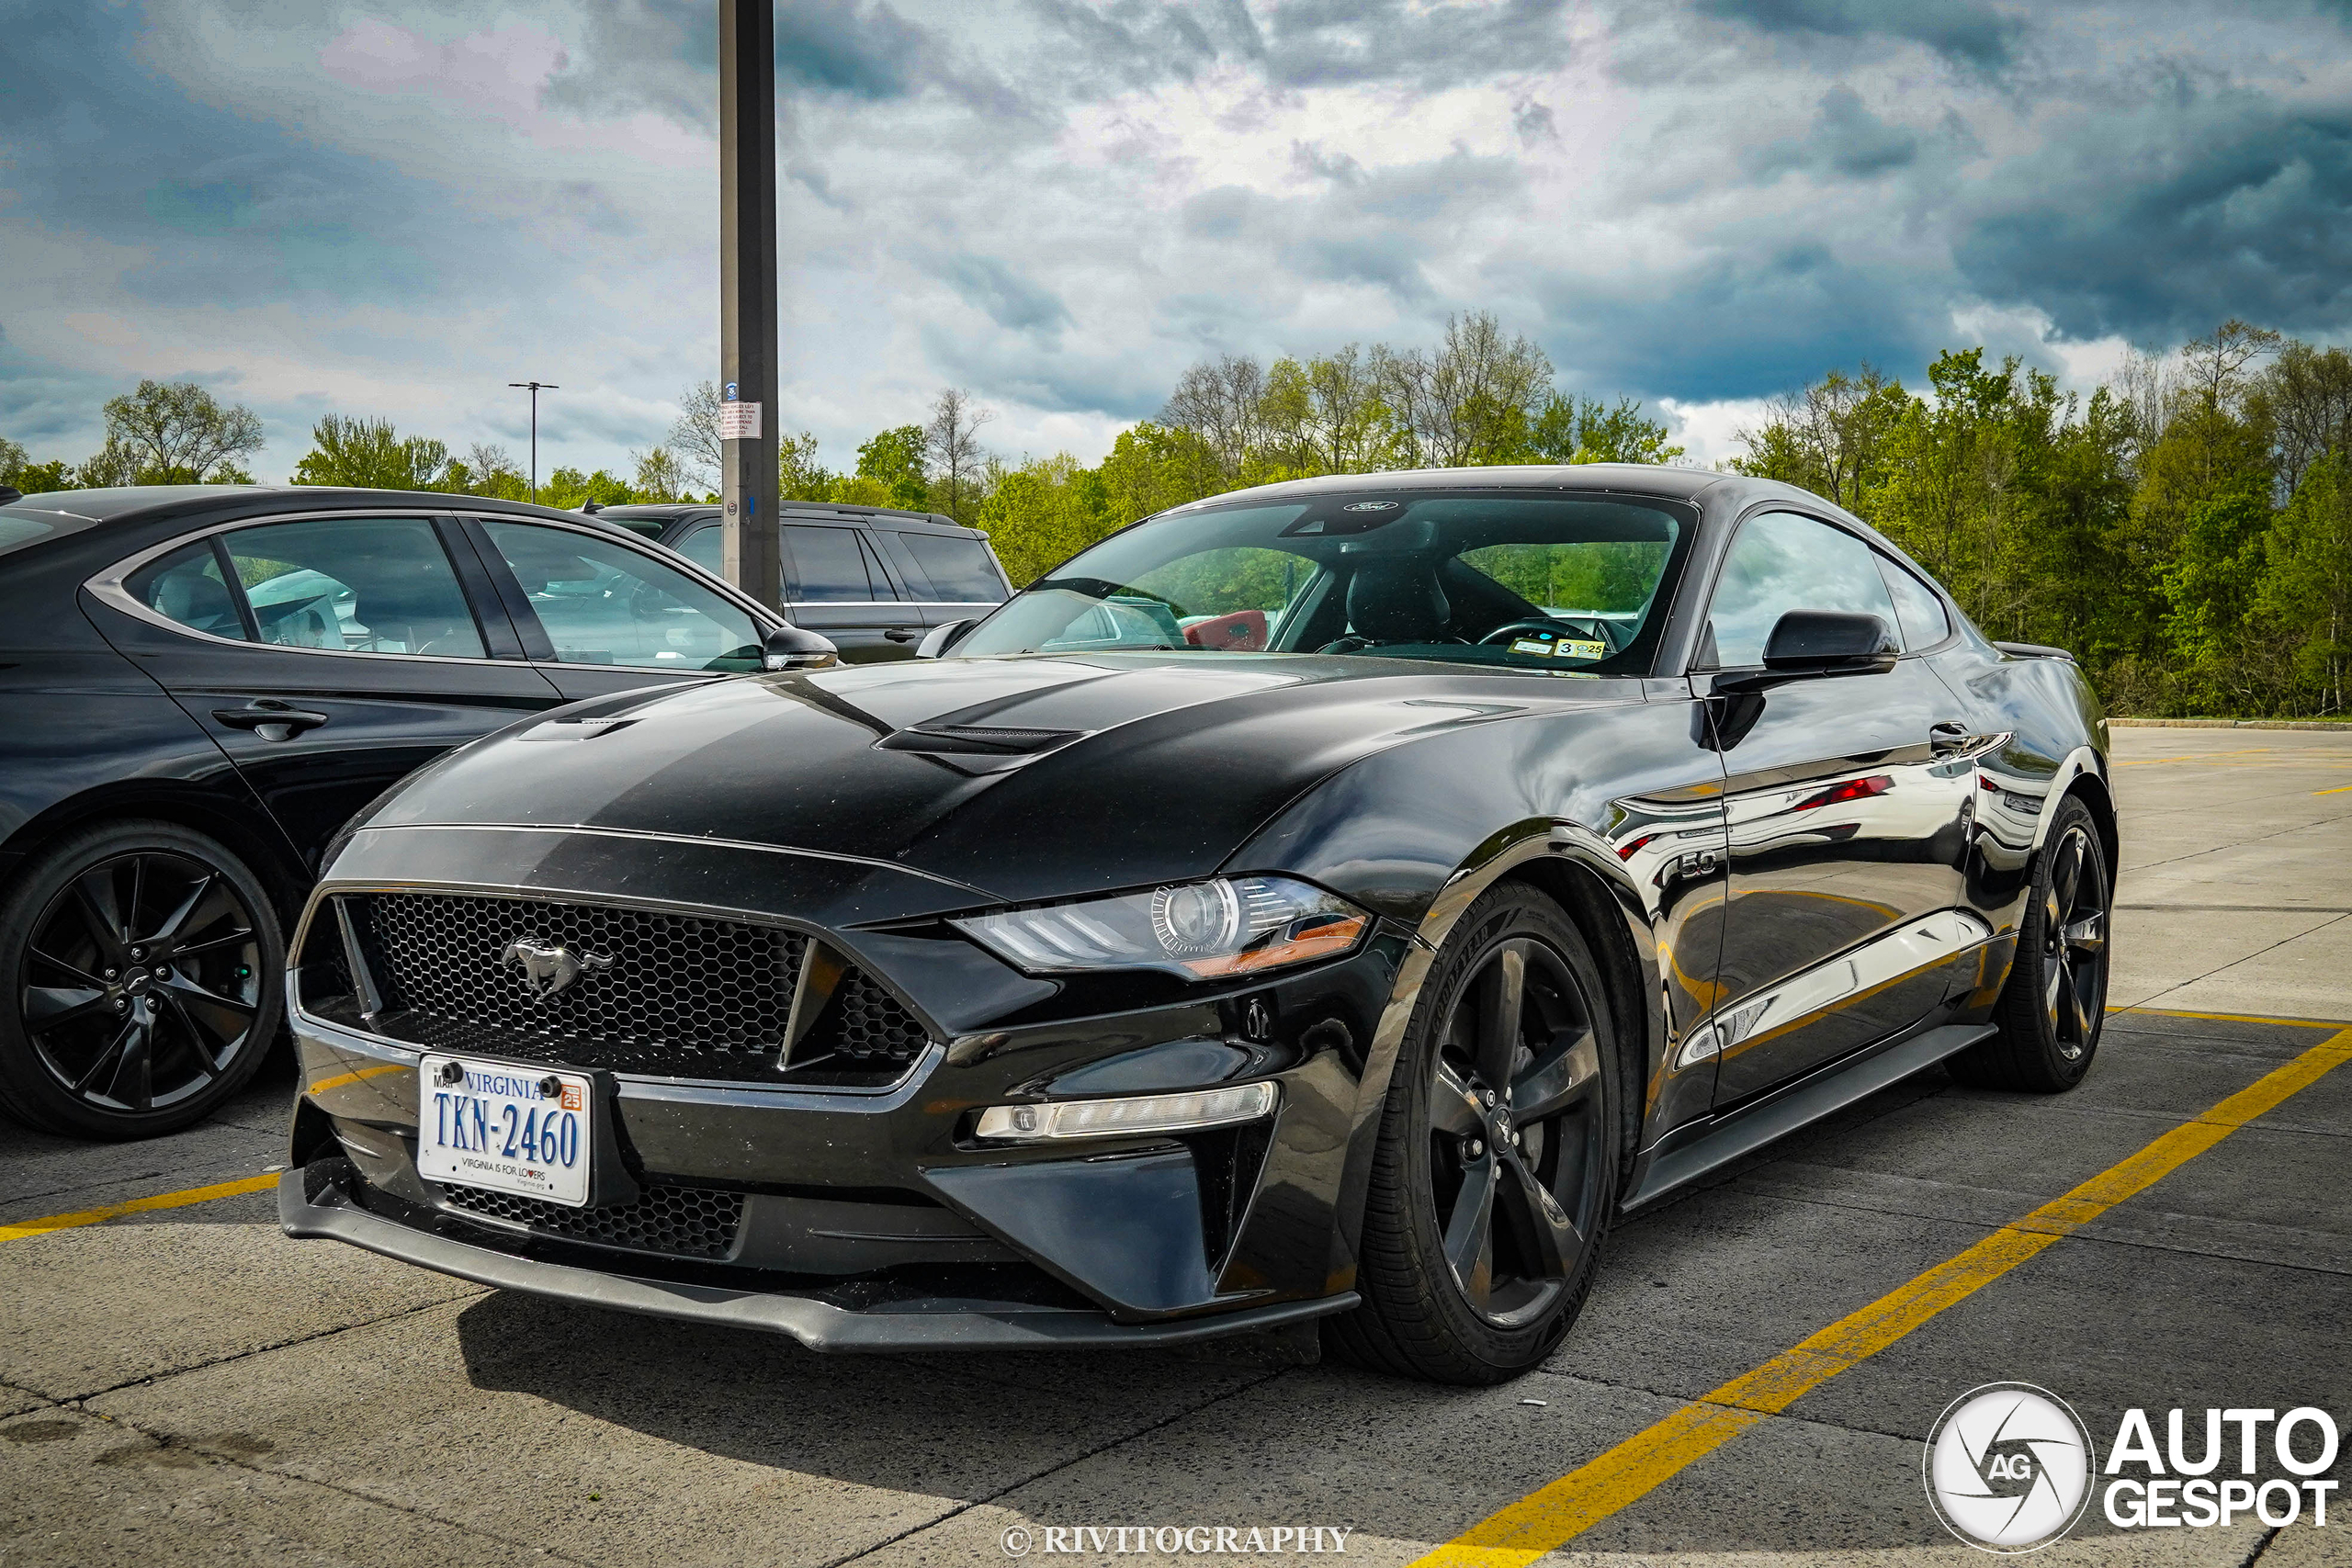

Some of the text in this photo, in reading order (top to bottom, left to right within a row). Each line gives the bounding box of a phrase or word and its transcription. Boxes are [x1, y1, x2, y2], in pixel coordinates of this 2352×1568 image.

[1561, 643, 1602, 653] 3 25
[466, 1071, 545, 1101] VIRGINIA
[564, 1094, 580, 1109] 25
[434, 1092, 578, 1168] TKN-2460
[462, 1157, 493, 1171] VIRGINIA
[495, 1164, 501, 1173] IS
[503, 1165, 517, 1176] FOR
